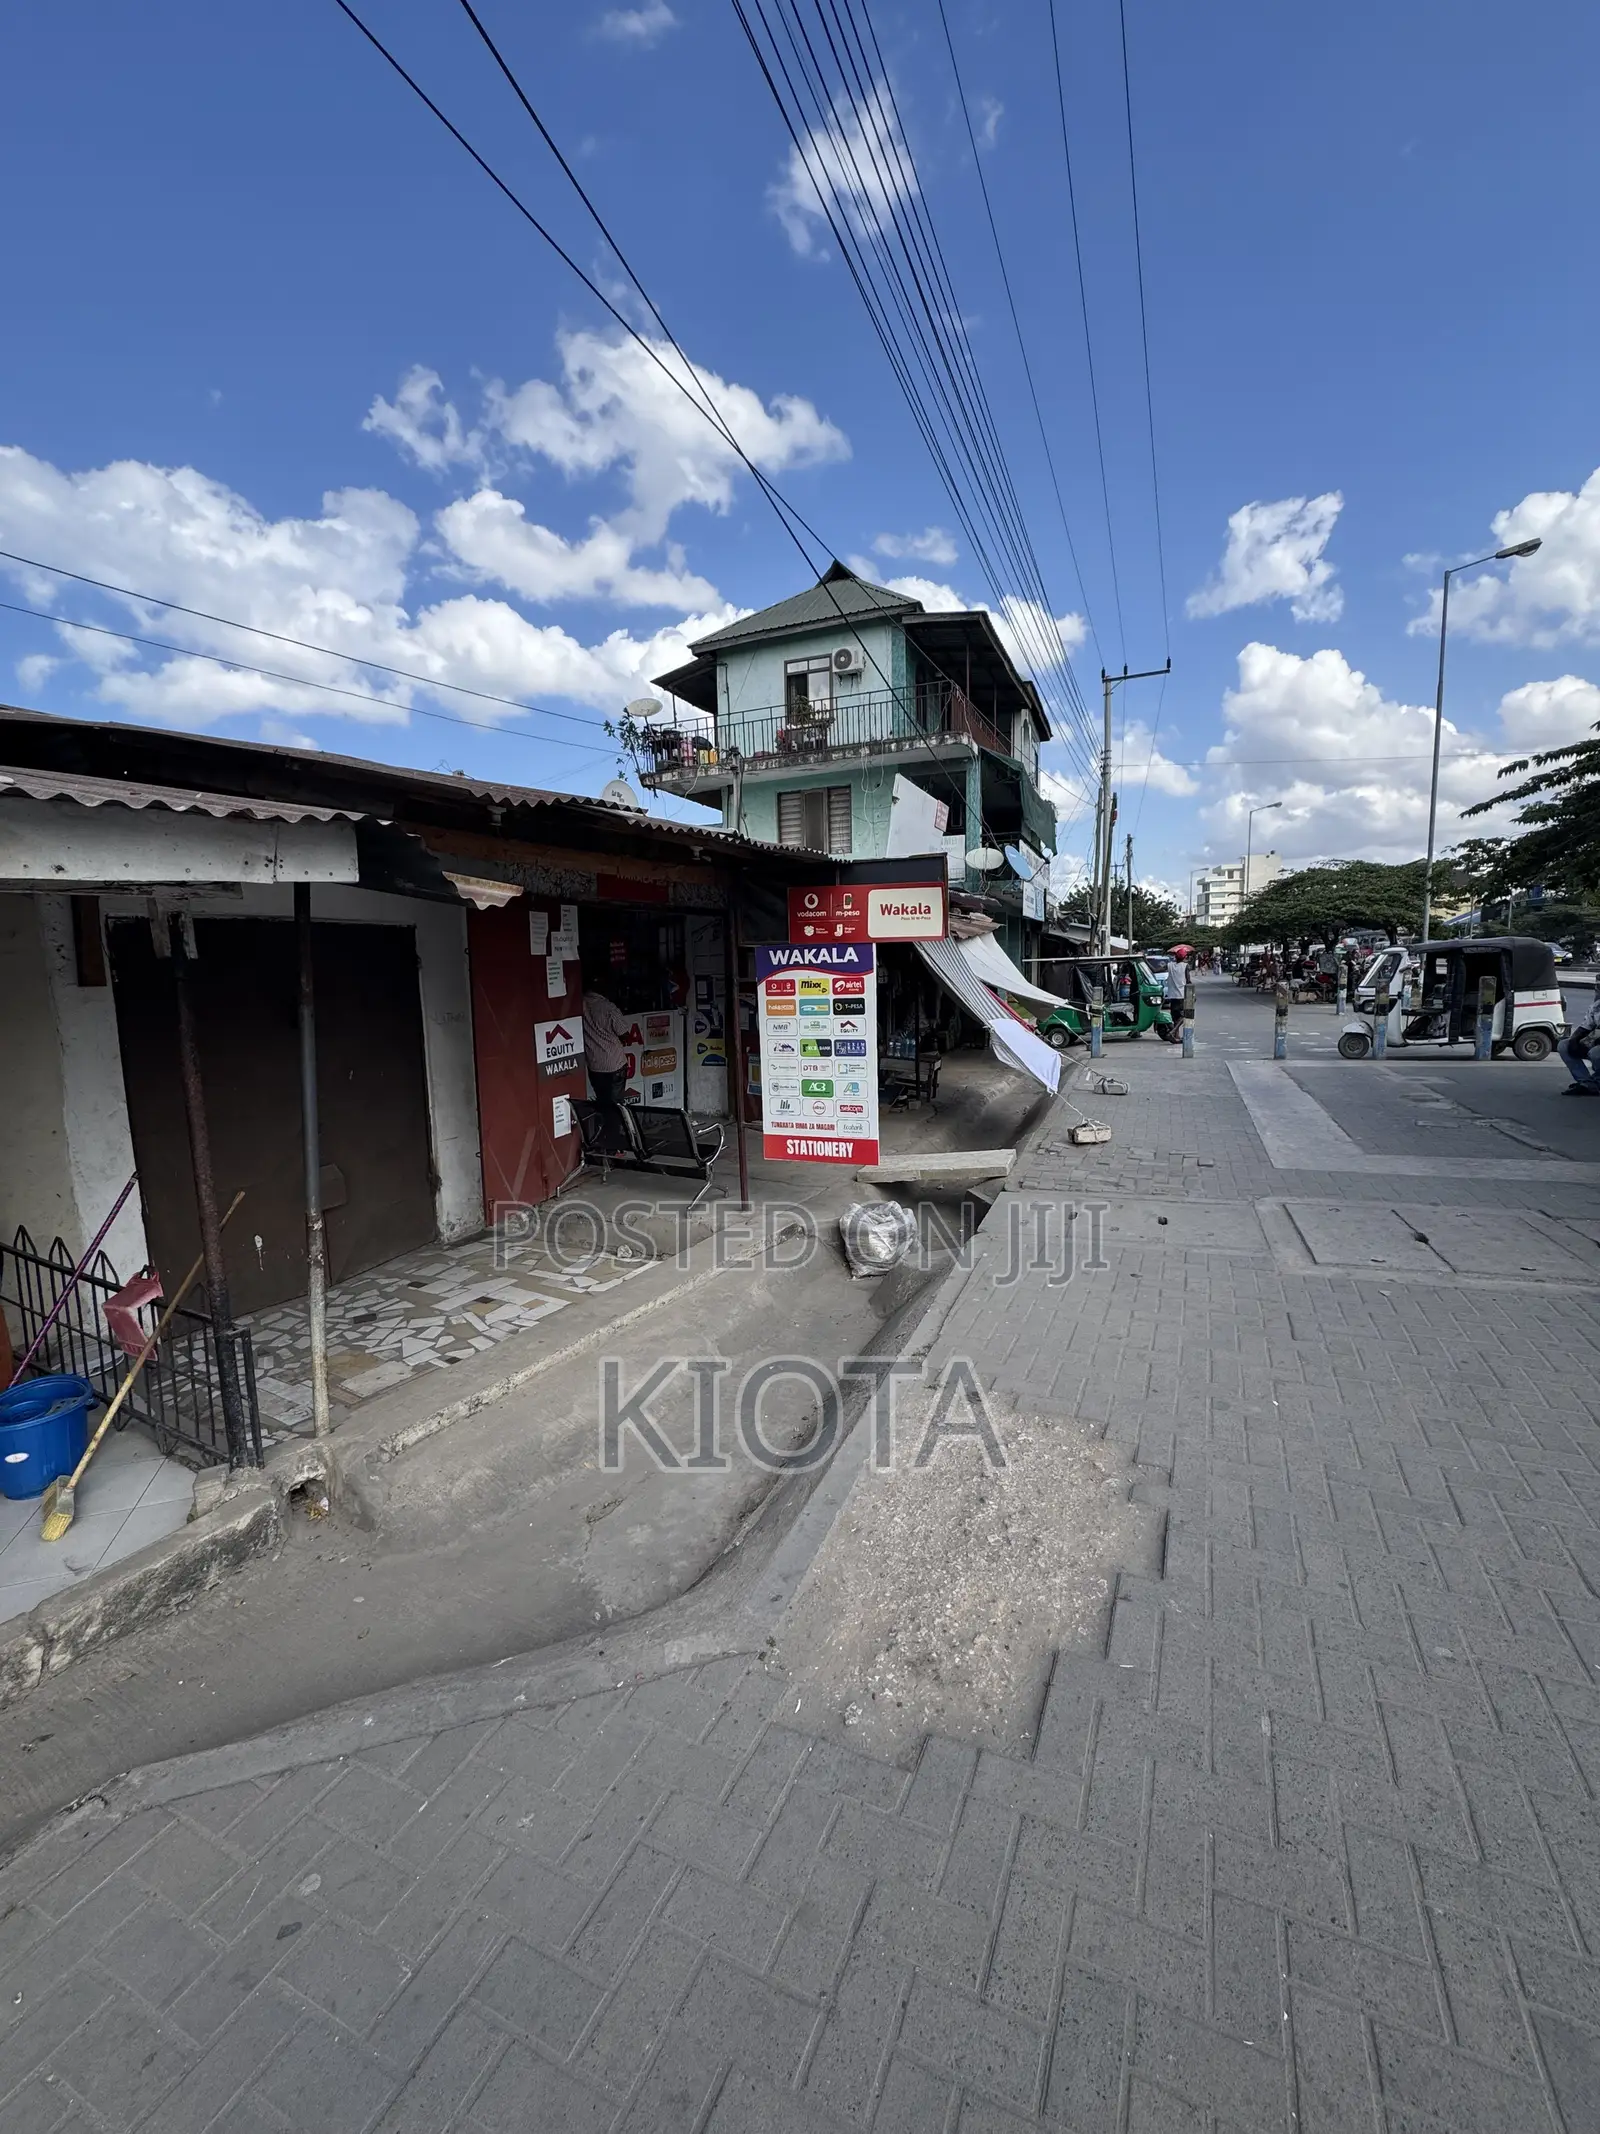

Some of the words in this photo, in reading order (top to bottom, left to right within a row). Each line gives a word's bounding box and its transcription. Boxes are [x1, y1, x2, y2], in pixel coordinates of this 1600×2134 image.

[797, 910, 827, 918] vodacom
[835, 910, 860, 918] m-pesa
[880, 902, 932, 916] Wakala
[768, 946, 859, 966] WAKALA
[801, 980, 822, 989] Mixx
[845, 980, 863, 989] airtel
[546, 1042, 575, 1058] EQUITY
[545, 1058, 578, 1076] WAKALA
[786, 1139, 854, 1158] STATIONERY
